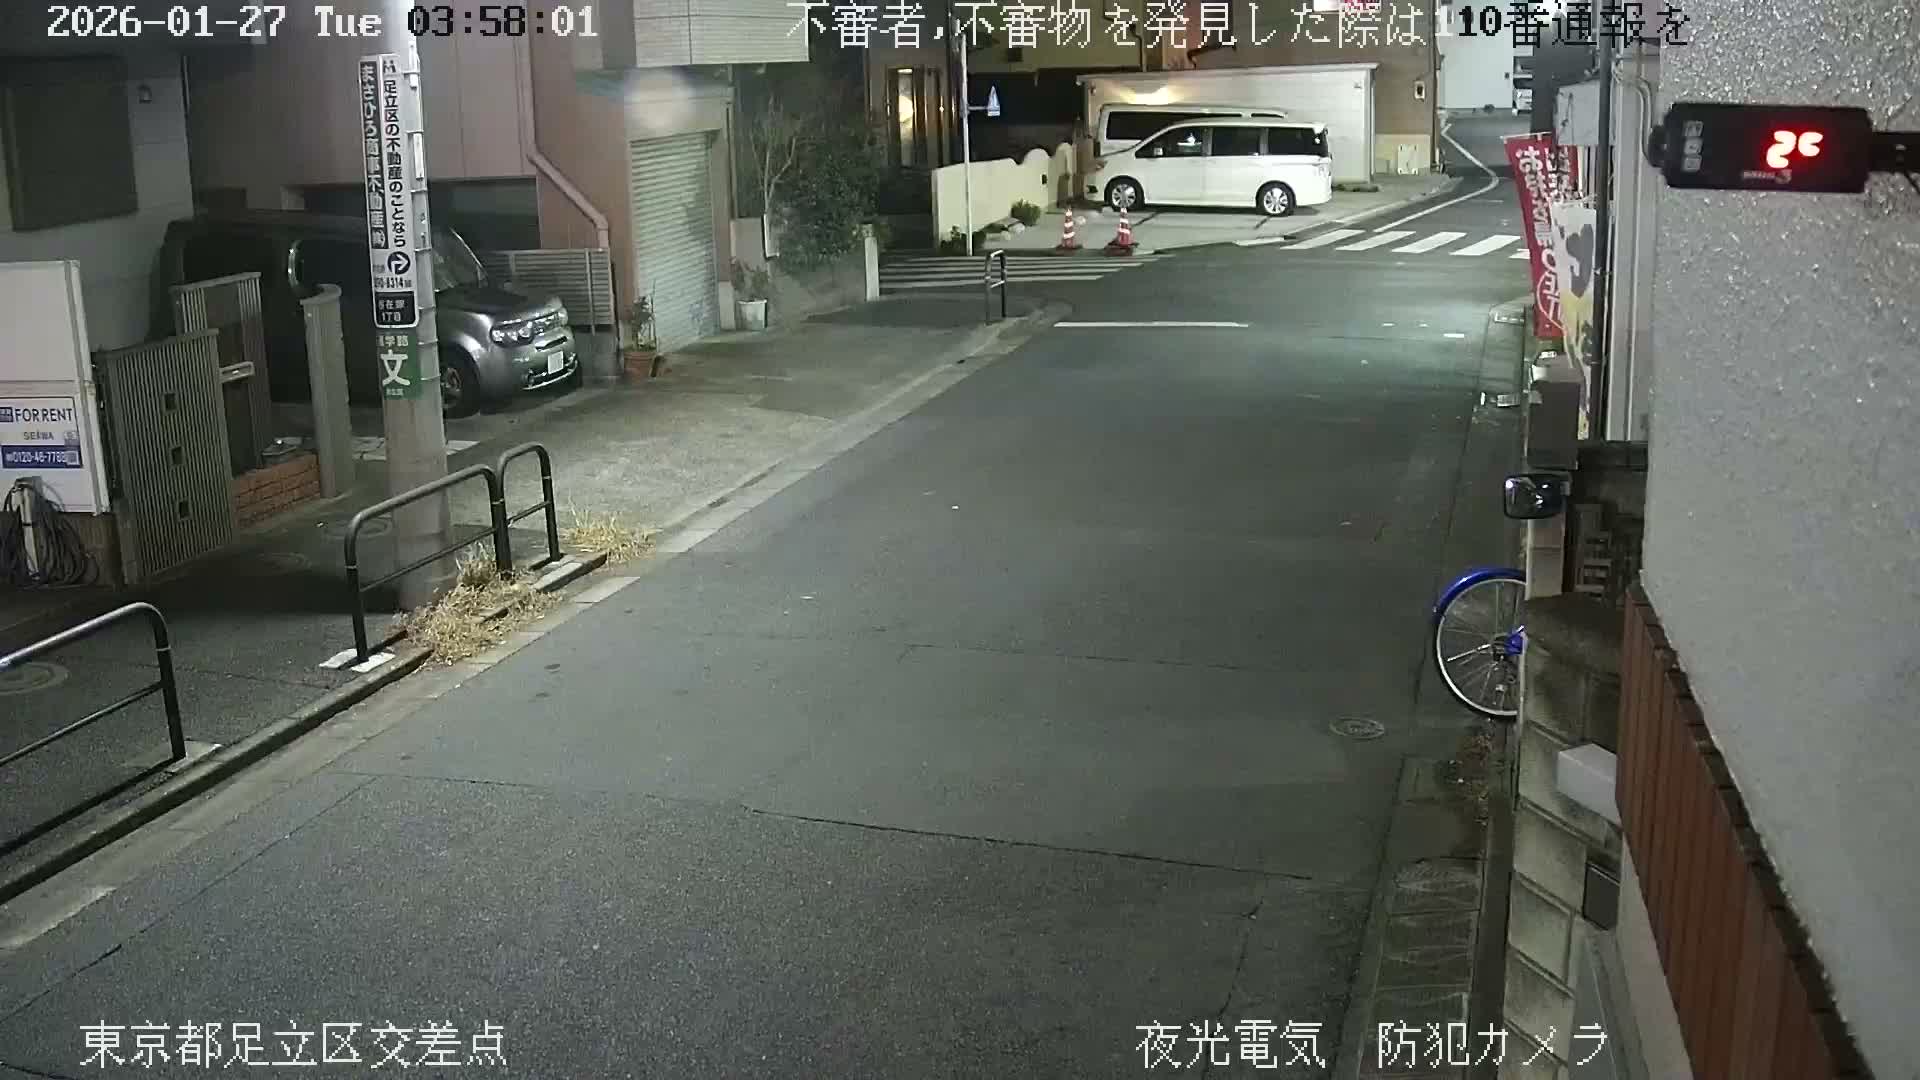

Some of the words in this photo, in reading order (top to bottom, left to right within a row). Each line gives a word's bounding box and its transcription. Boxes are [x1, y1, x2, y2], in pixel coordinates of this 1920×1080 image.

[384, 80, 406, 247] 足立区の不動産のことなら
[380, 349, 410, 386] 文
[15, 408, 39, 422] FOR
[41, 408, 73, 422] RENT
